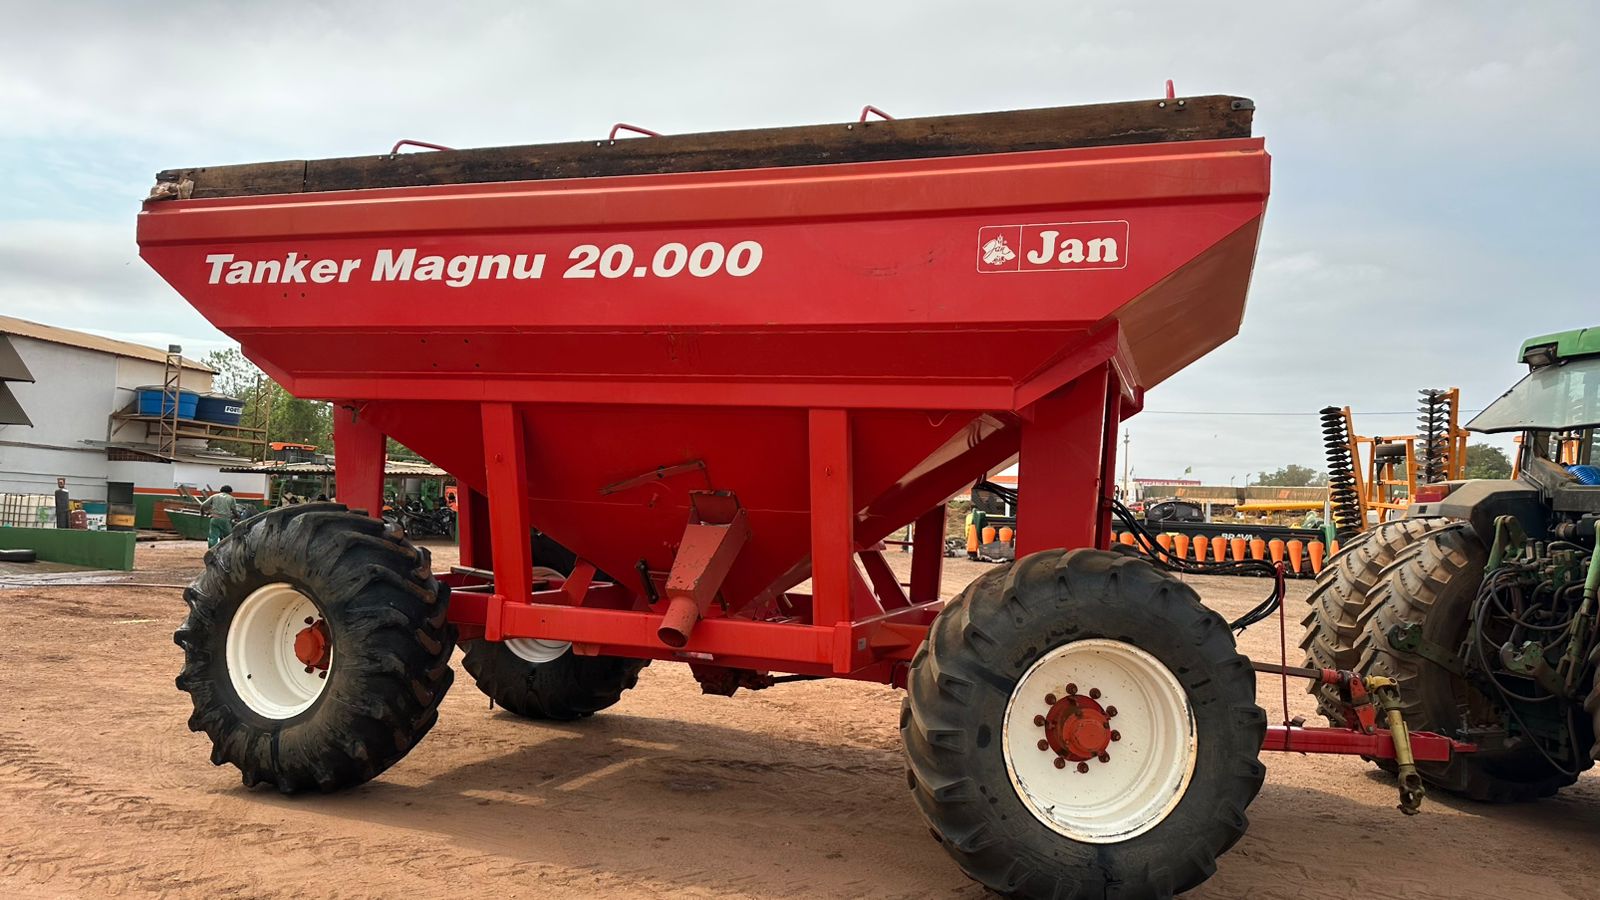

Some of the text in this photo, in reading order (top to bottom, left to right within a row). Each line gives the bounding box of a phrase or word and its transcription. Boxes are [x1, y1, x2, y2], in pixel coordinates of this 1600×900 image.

[205, 240, 764, 287] Tanker Magnu 20.000
[1027, 230, 1118, 264] Jan
